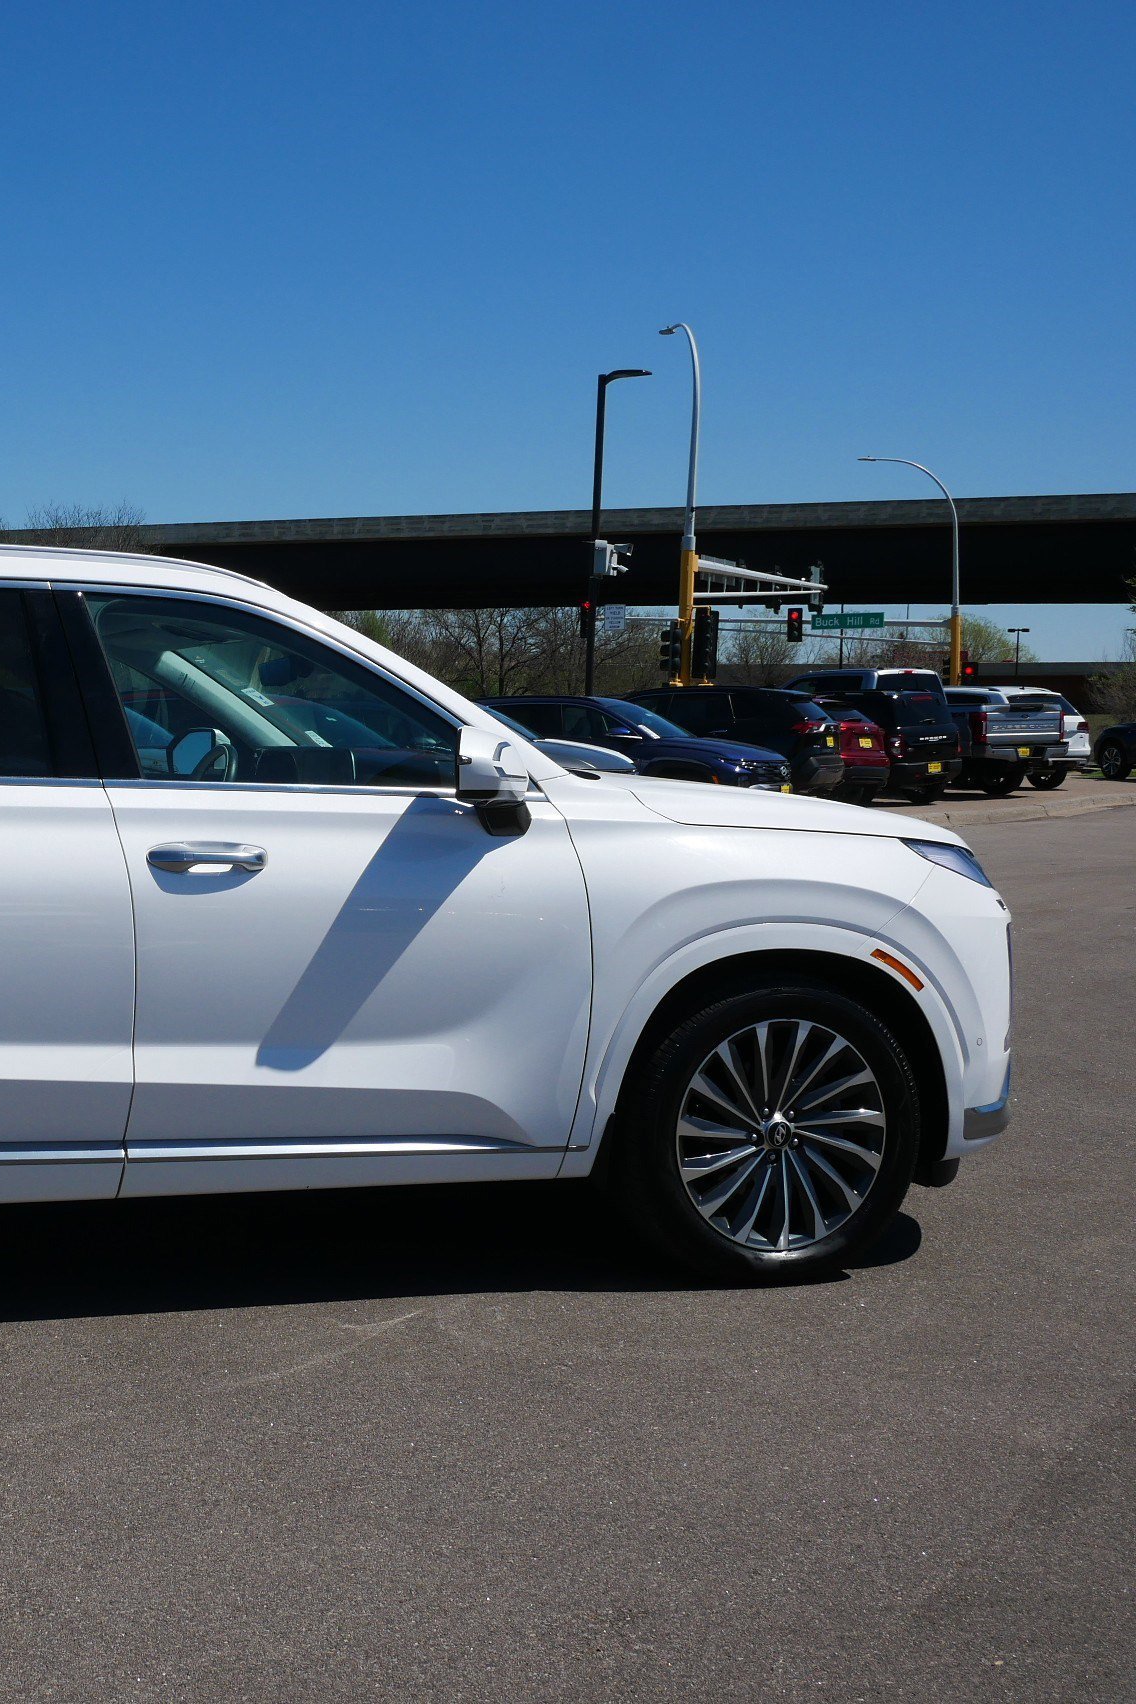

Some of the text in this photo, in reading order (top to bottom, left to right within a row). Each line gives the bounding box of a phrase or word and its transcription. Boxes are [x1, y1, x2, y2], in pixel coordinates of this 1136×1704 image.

[815, 616, 880, 627] Buck Hill Rd
